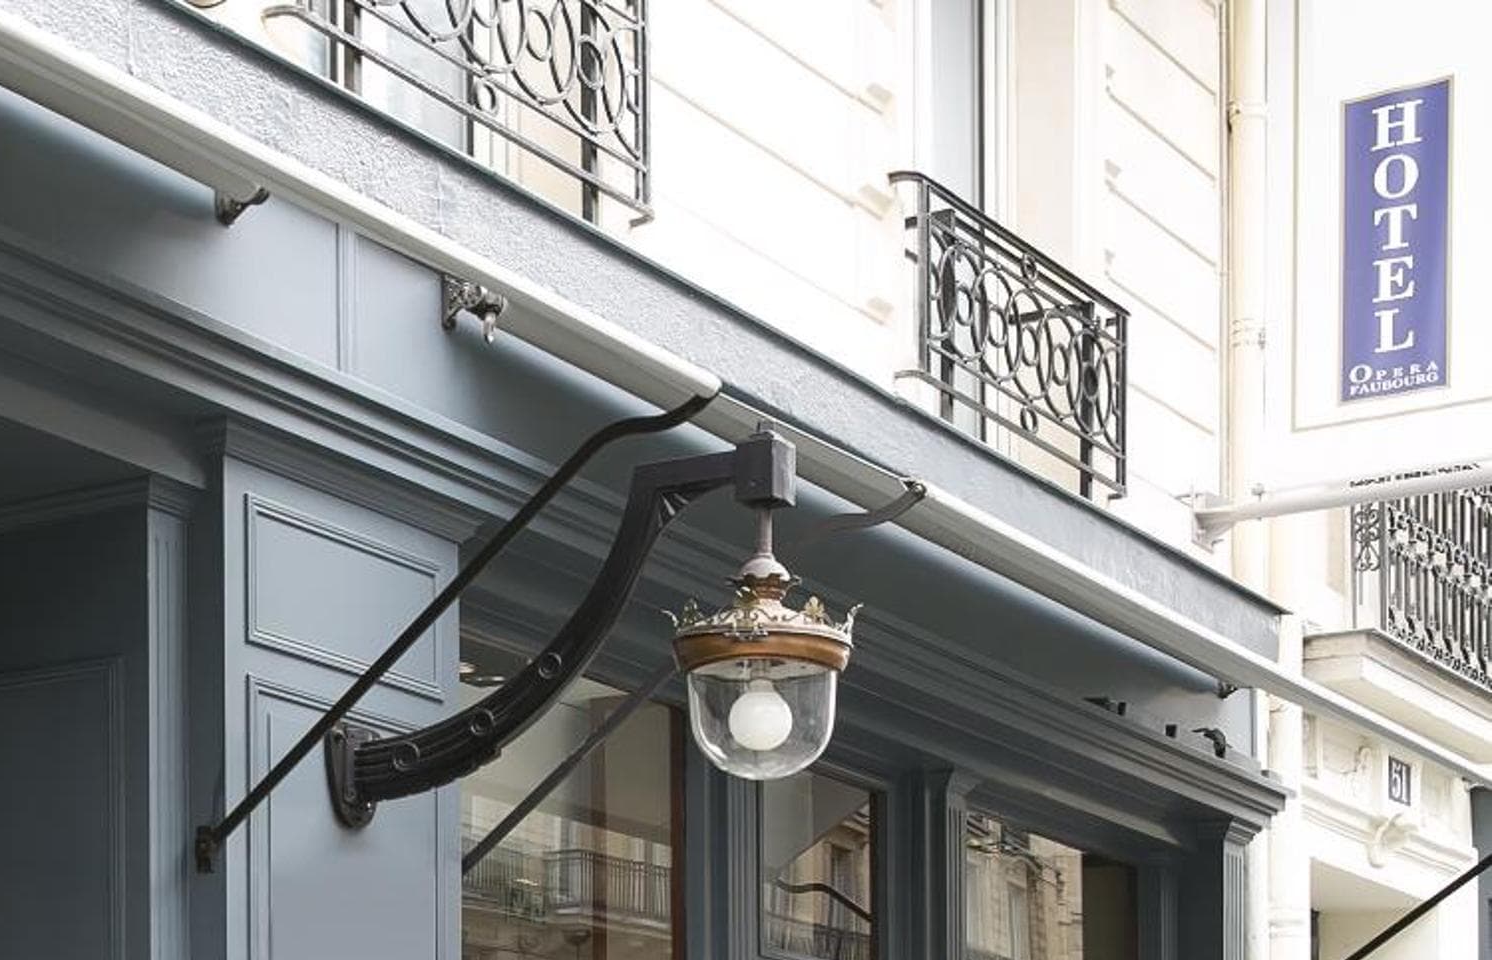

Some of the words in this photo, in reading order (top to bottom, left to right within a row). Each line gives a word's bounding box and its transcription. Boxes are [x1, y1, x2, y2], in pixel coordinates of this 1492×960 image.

[1371, 99, 1423, 353] HOTEL
[1350, 372, 1439, 395] FAUBOURG
[1392, 759, 1407, 803] 51
